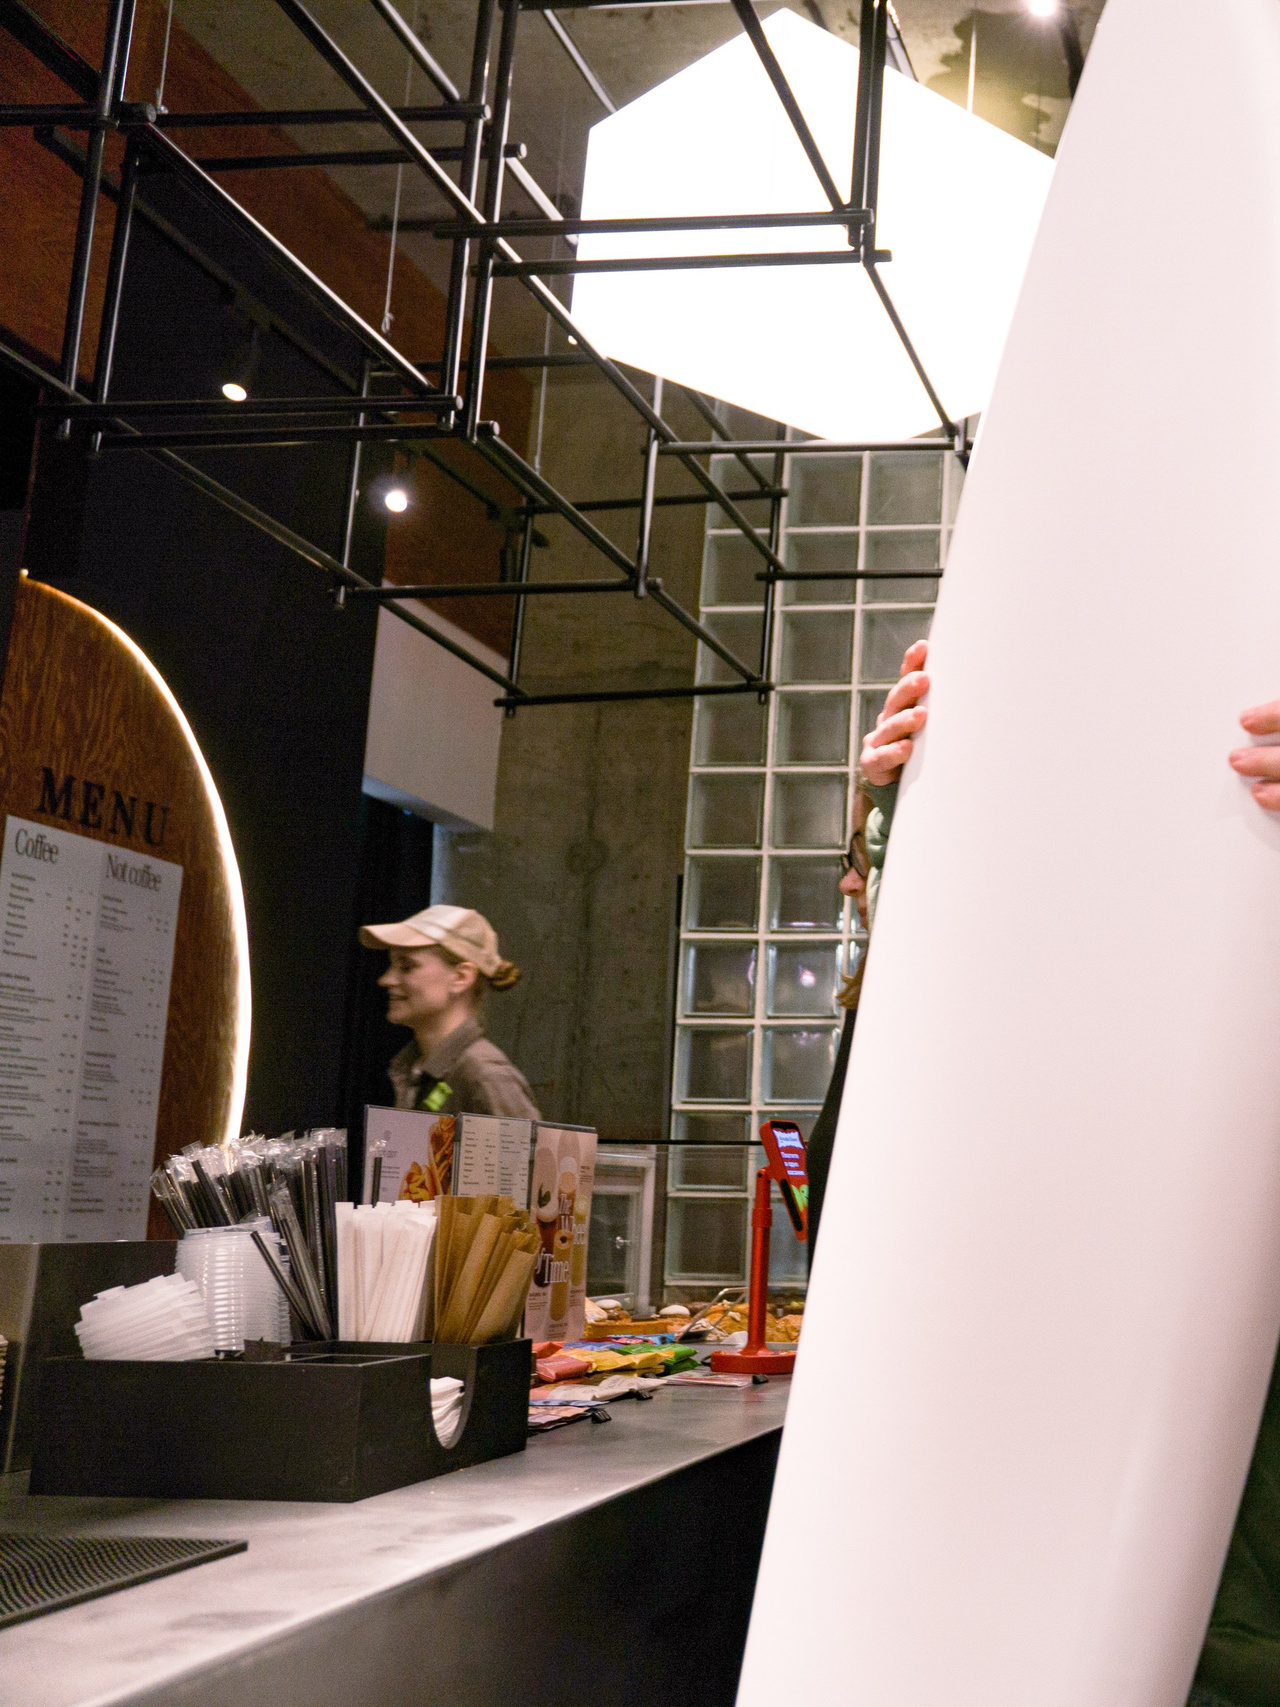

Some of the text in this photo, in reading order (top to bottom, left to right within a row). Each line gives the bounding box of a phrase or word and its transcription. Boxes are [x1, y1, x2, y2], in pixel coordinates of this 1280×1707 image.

[36, 767, 169, 846] MENU
[16, 828, 60, 864] Coffee
[106, 853, 162, 891] Not coffee
[558, 1193, 573, 1215] The
[543, 1252, 570, 1284] Time
